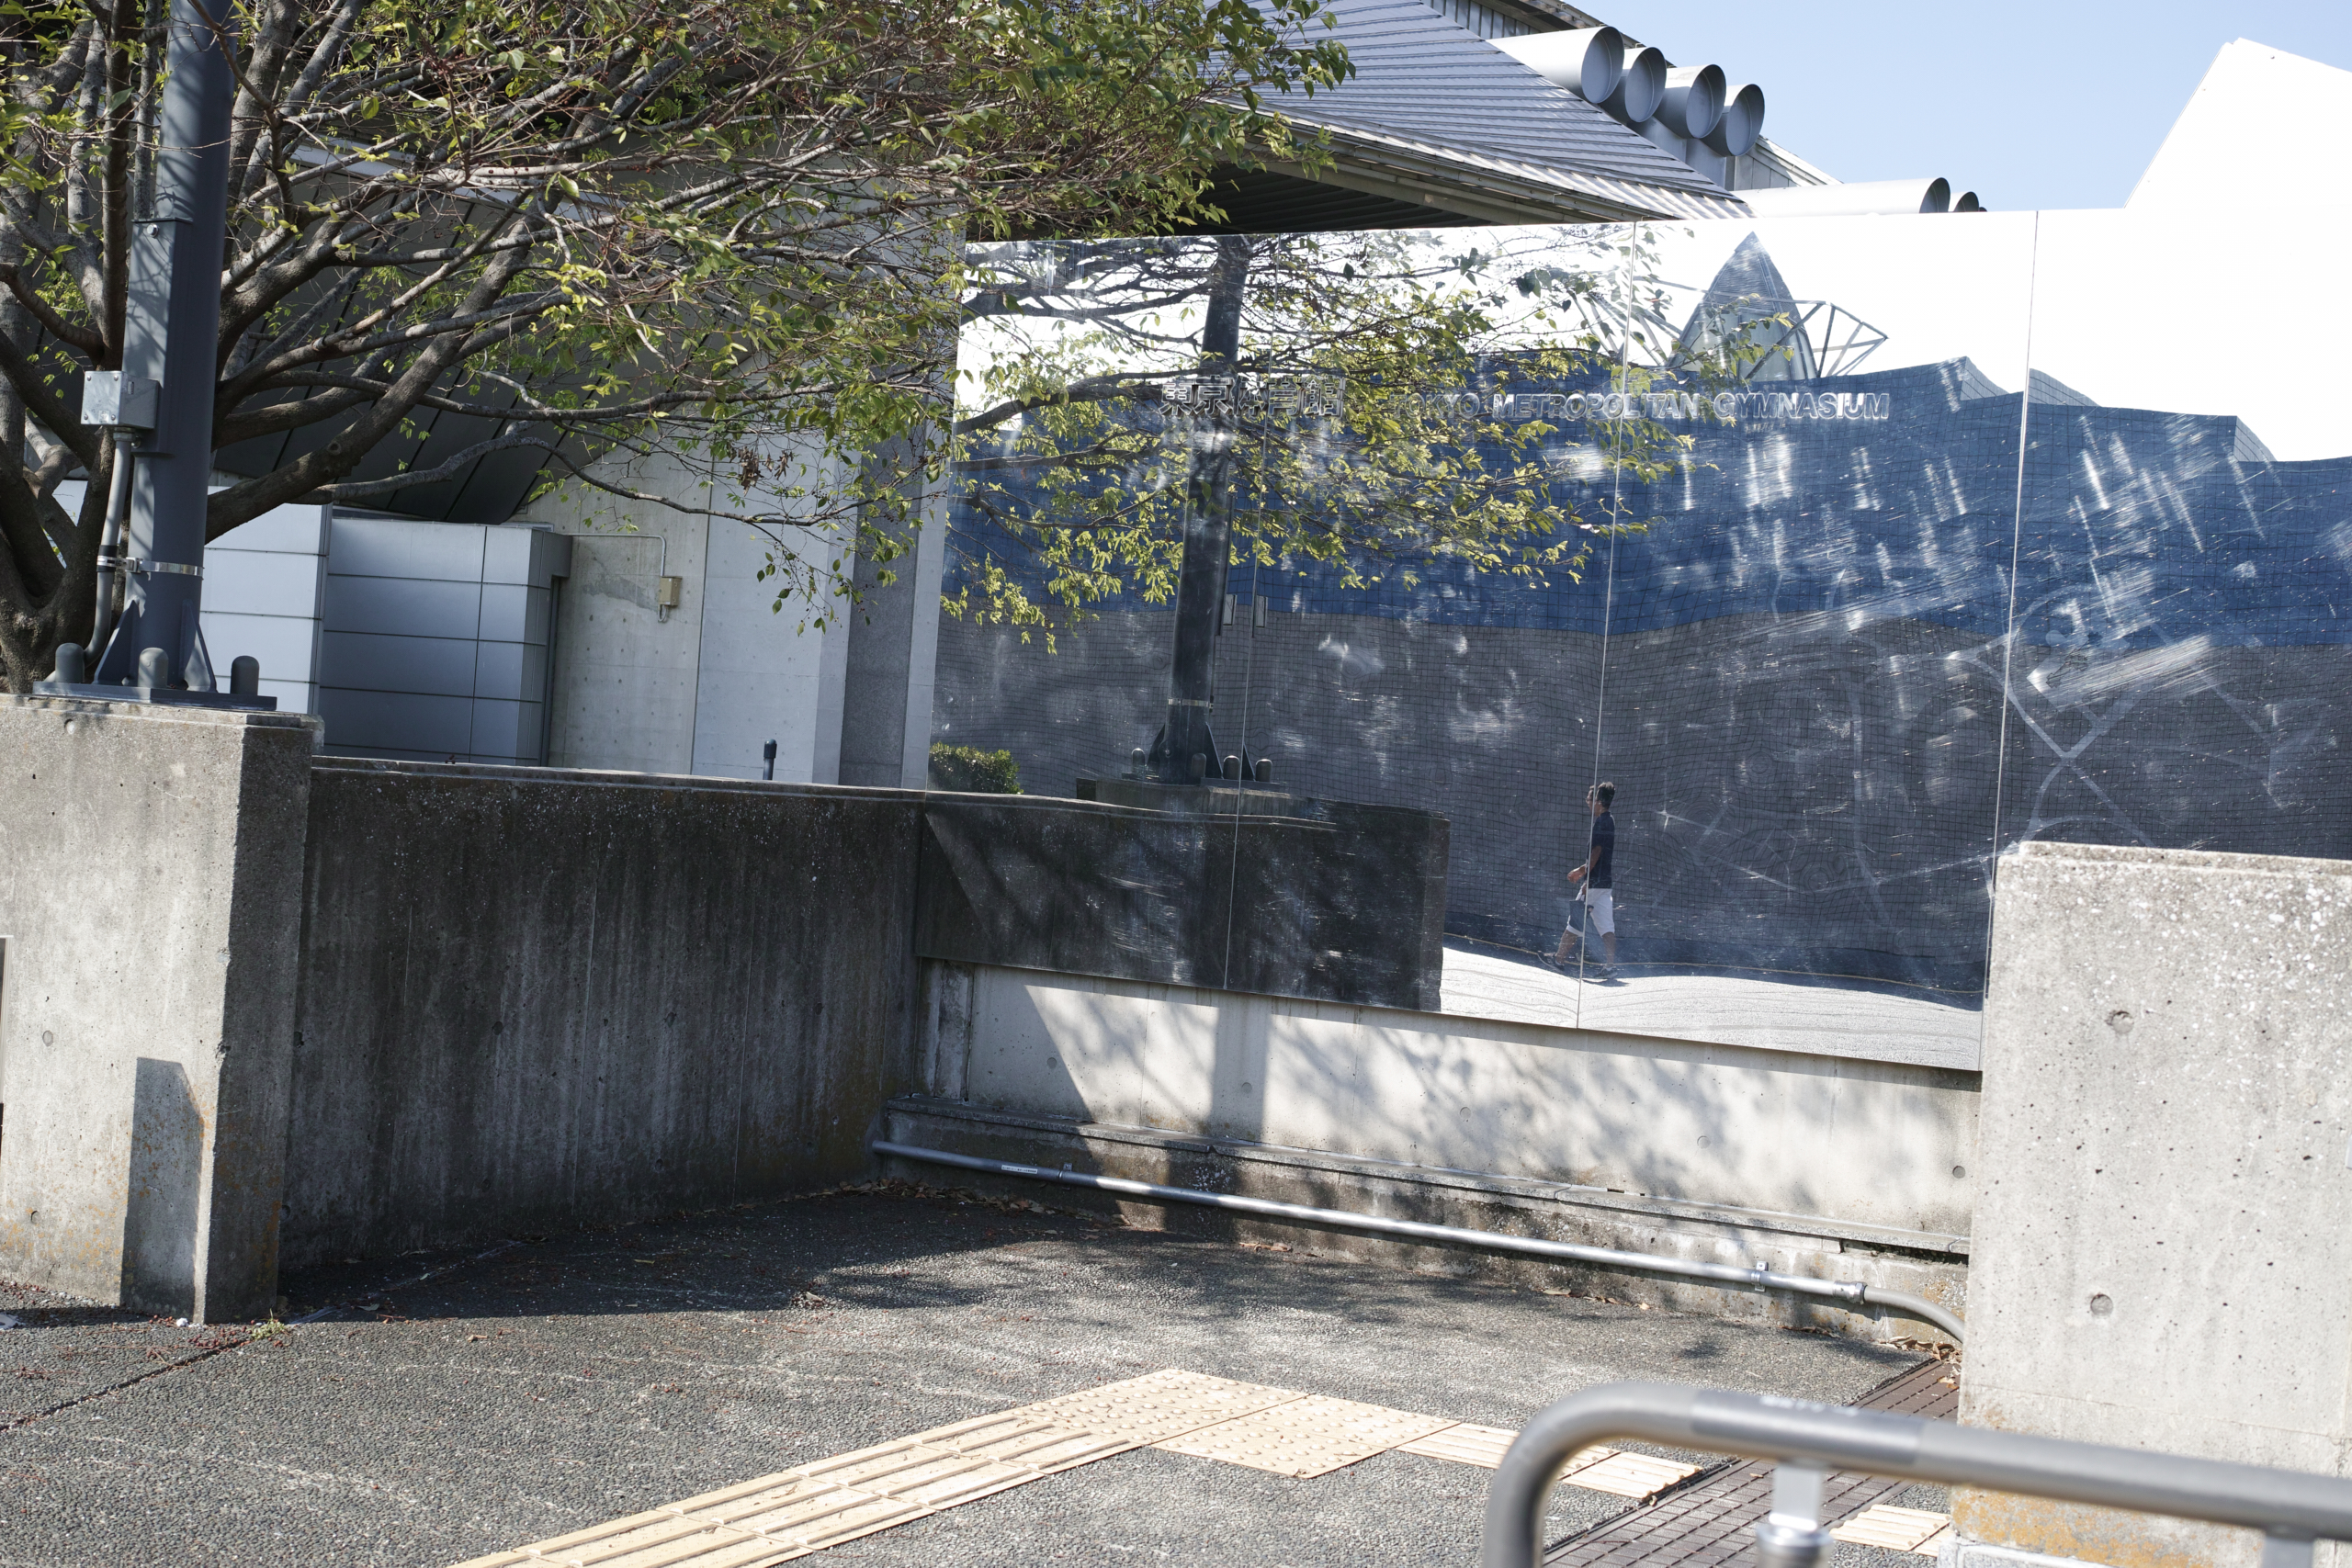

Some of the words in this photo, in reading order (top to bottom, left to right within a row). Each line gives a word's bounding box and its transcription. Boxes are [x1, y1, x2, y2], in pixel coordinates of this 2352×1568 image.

[1159, 376, 1345, 417] 東京体育館
[1389, 392, 1480, 419] TOKYO
[1492, 392, 1700, 420] METROPOLITAN
[1713, 392, 1890, 420] GYMNASIUM
